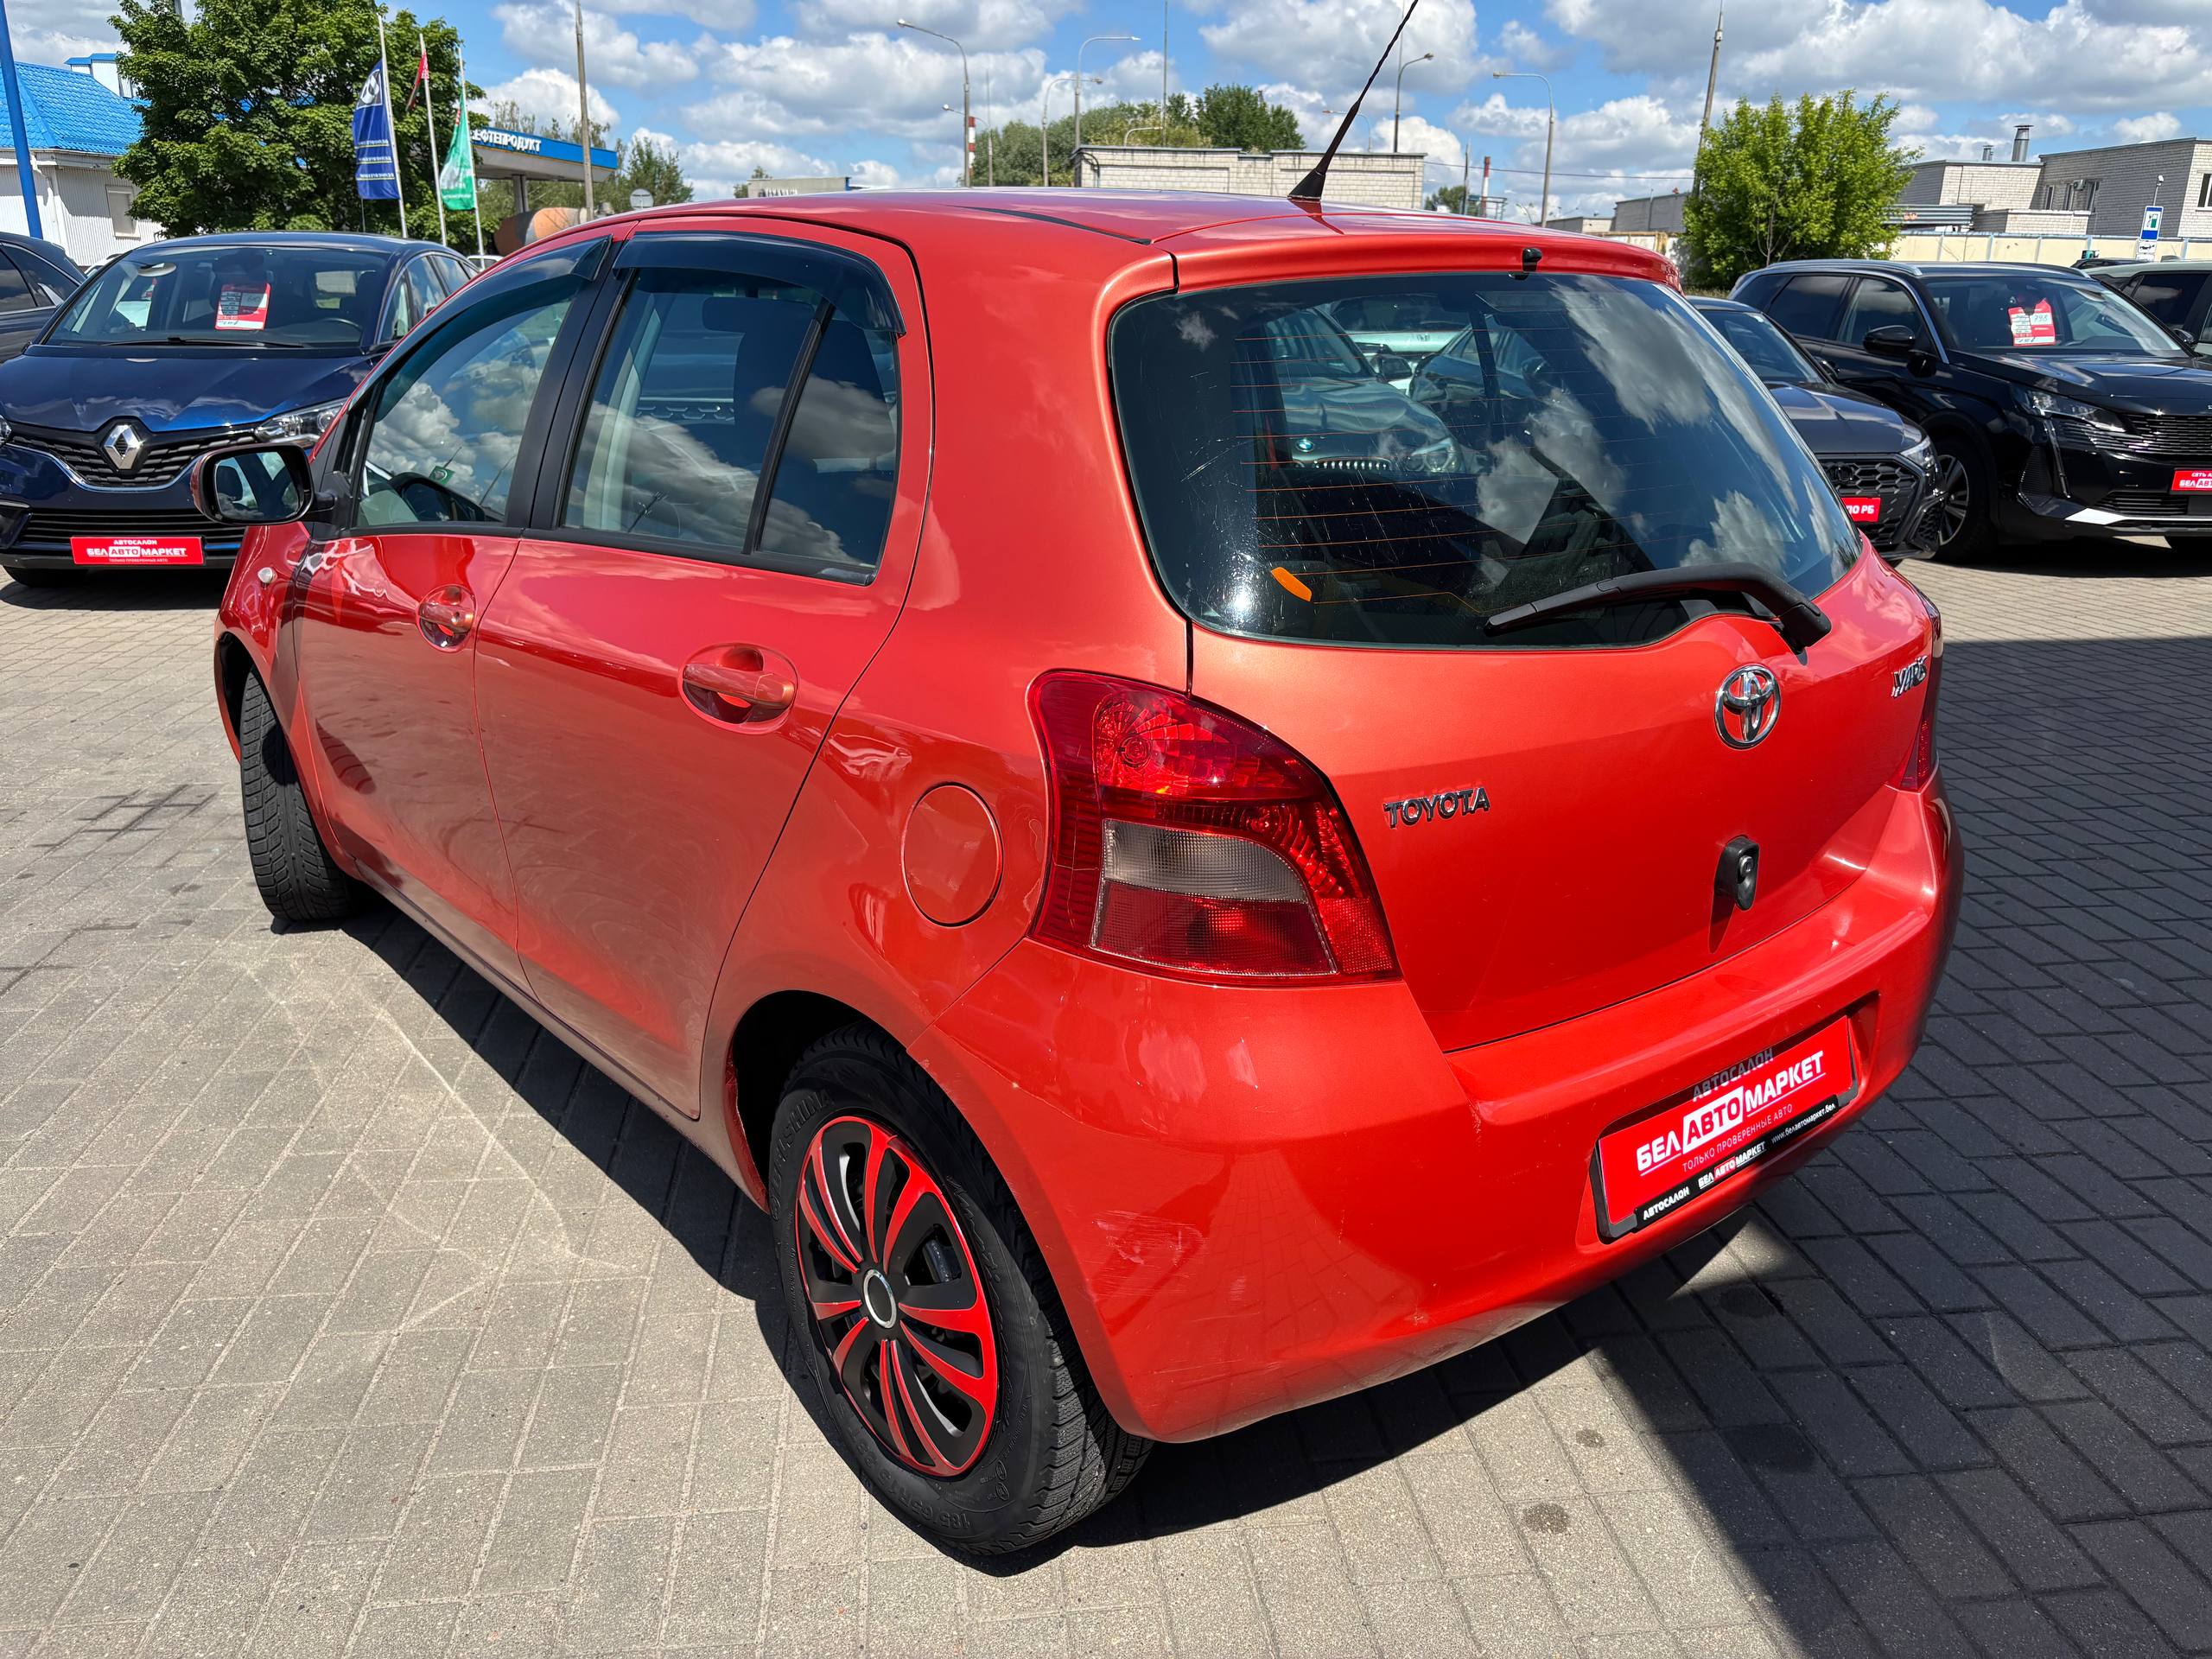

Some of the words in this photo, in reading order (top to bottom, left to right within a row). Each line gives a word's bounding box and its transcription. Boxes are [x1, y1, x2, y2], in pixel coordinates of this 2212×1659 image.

[1860, 505, 1875, 514] РБ
[1382, 787, 1491, 829] TOYOTA
[1692, 1048, 1774, 1102] АВТОСАЛОН
[1643, 1186, 1690, 1220] АВТОСАЛОН
[1771, 1103, 1835, 1144] www.белавтомаркет.бел
[1682, 1147, 1714, 1172] ТОЛЬКО
[1716, 1114, 1772, 1153] ПРОВЕРЕННЫЕ
[1773, 1103, 1793, 1122] АВТО
